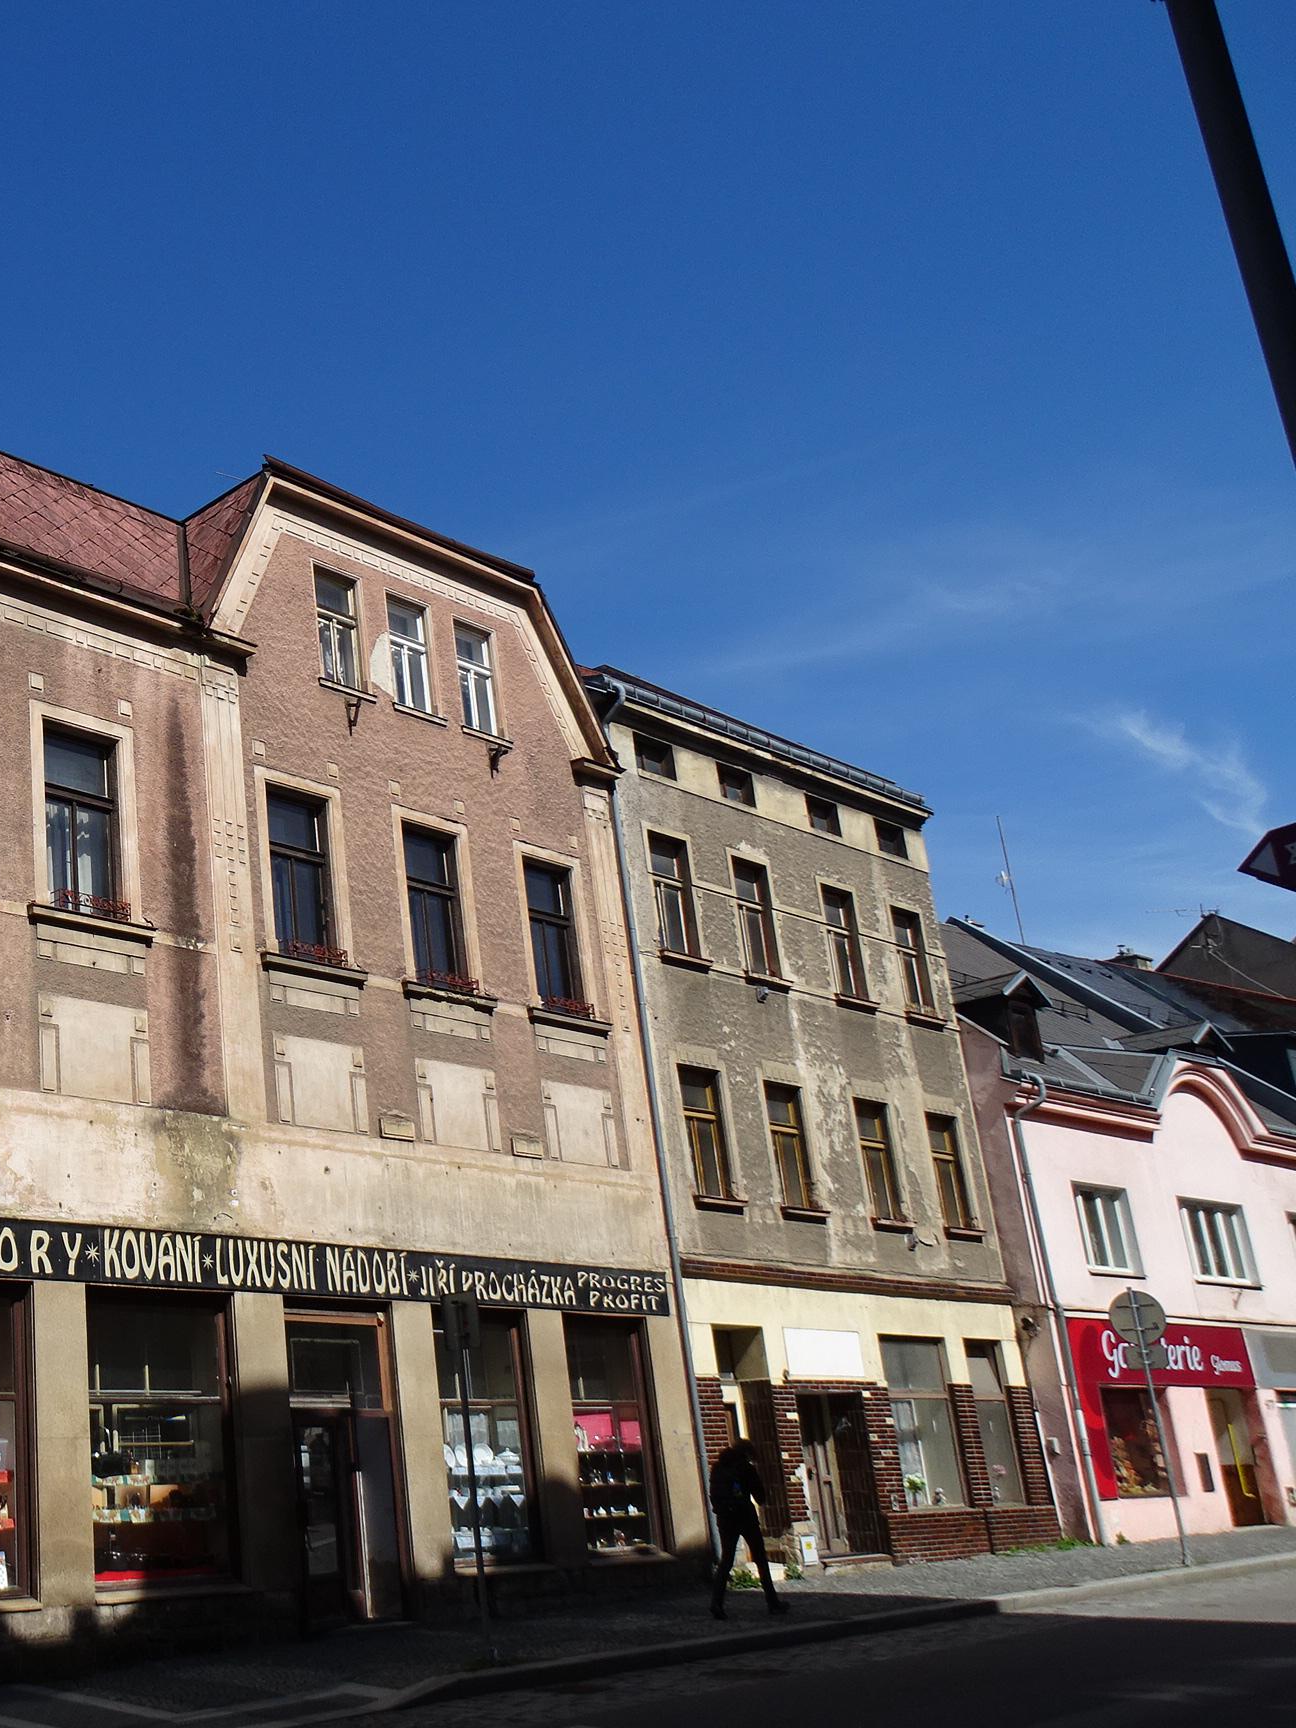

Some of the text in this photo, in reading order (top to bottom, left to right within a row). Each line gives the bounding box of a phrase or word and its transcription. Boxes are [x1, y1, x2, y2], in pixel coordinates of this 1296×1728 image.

[103, 1228, 202, 1284] KOVÁNÍ
[215, 1237, 317, 1290] LUXUSNÍ
[326, 1246, 408, 1296] NÁDOBÍ
[418, 1260, 455, 1297] JIŘÍ
[462, 1269, 576, 1306] PROCHÁZKA
[576, 1270, 666, 1293] PROGRES
[589, 1291, 660, 1312] PROFIT
